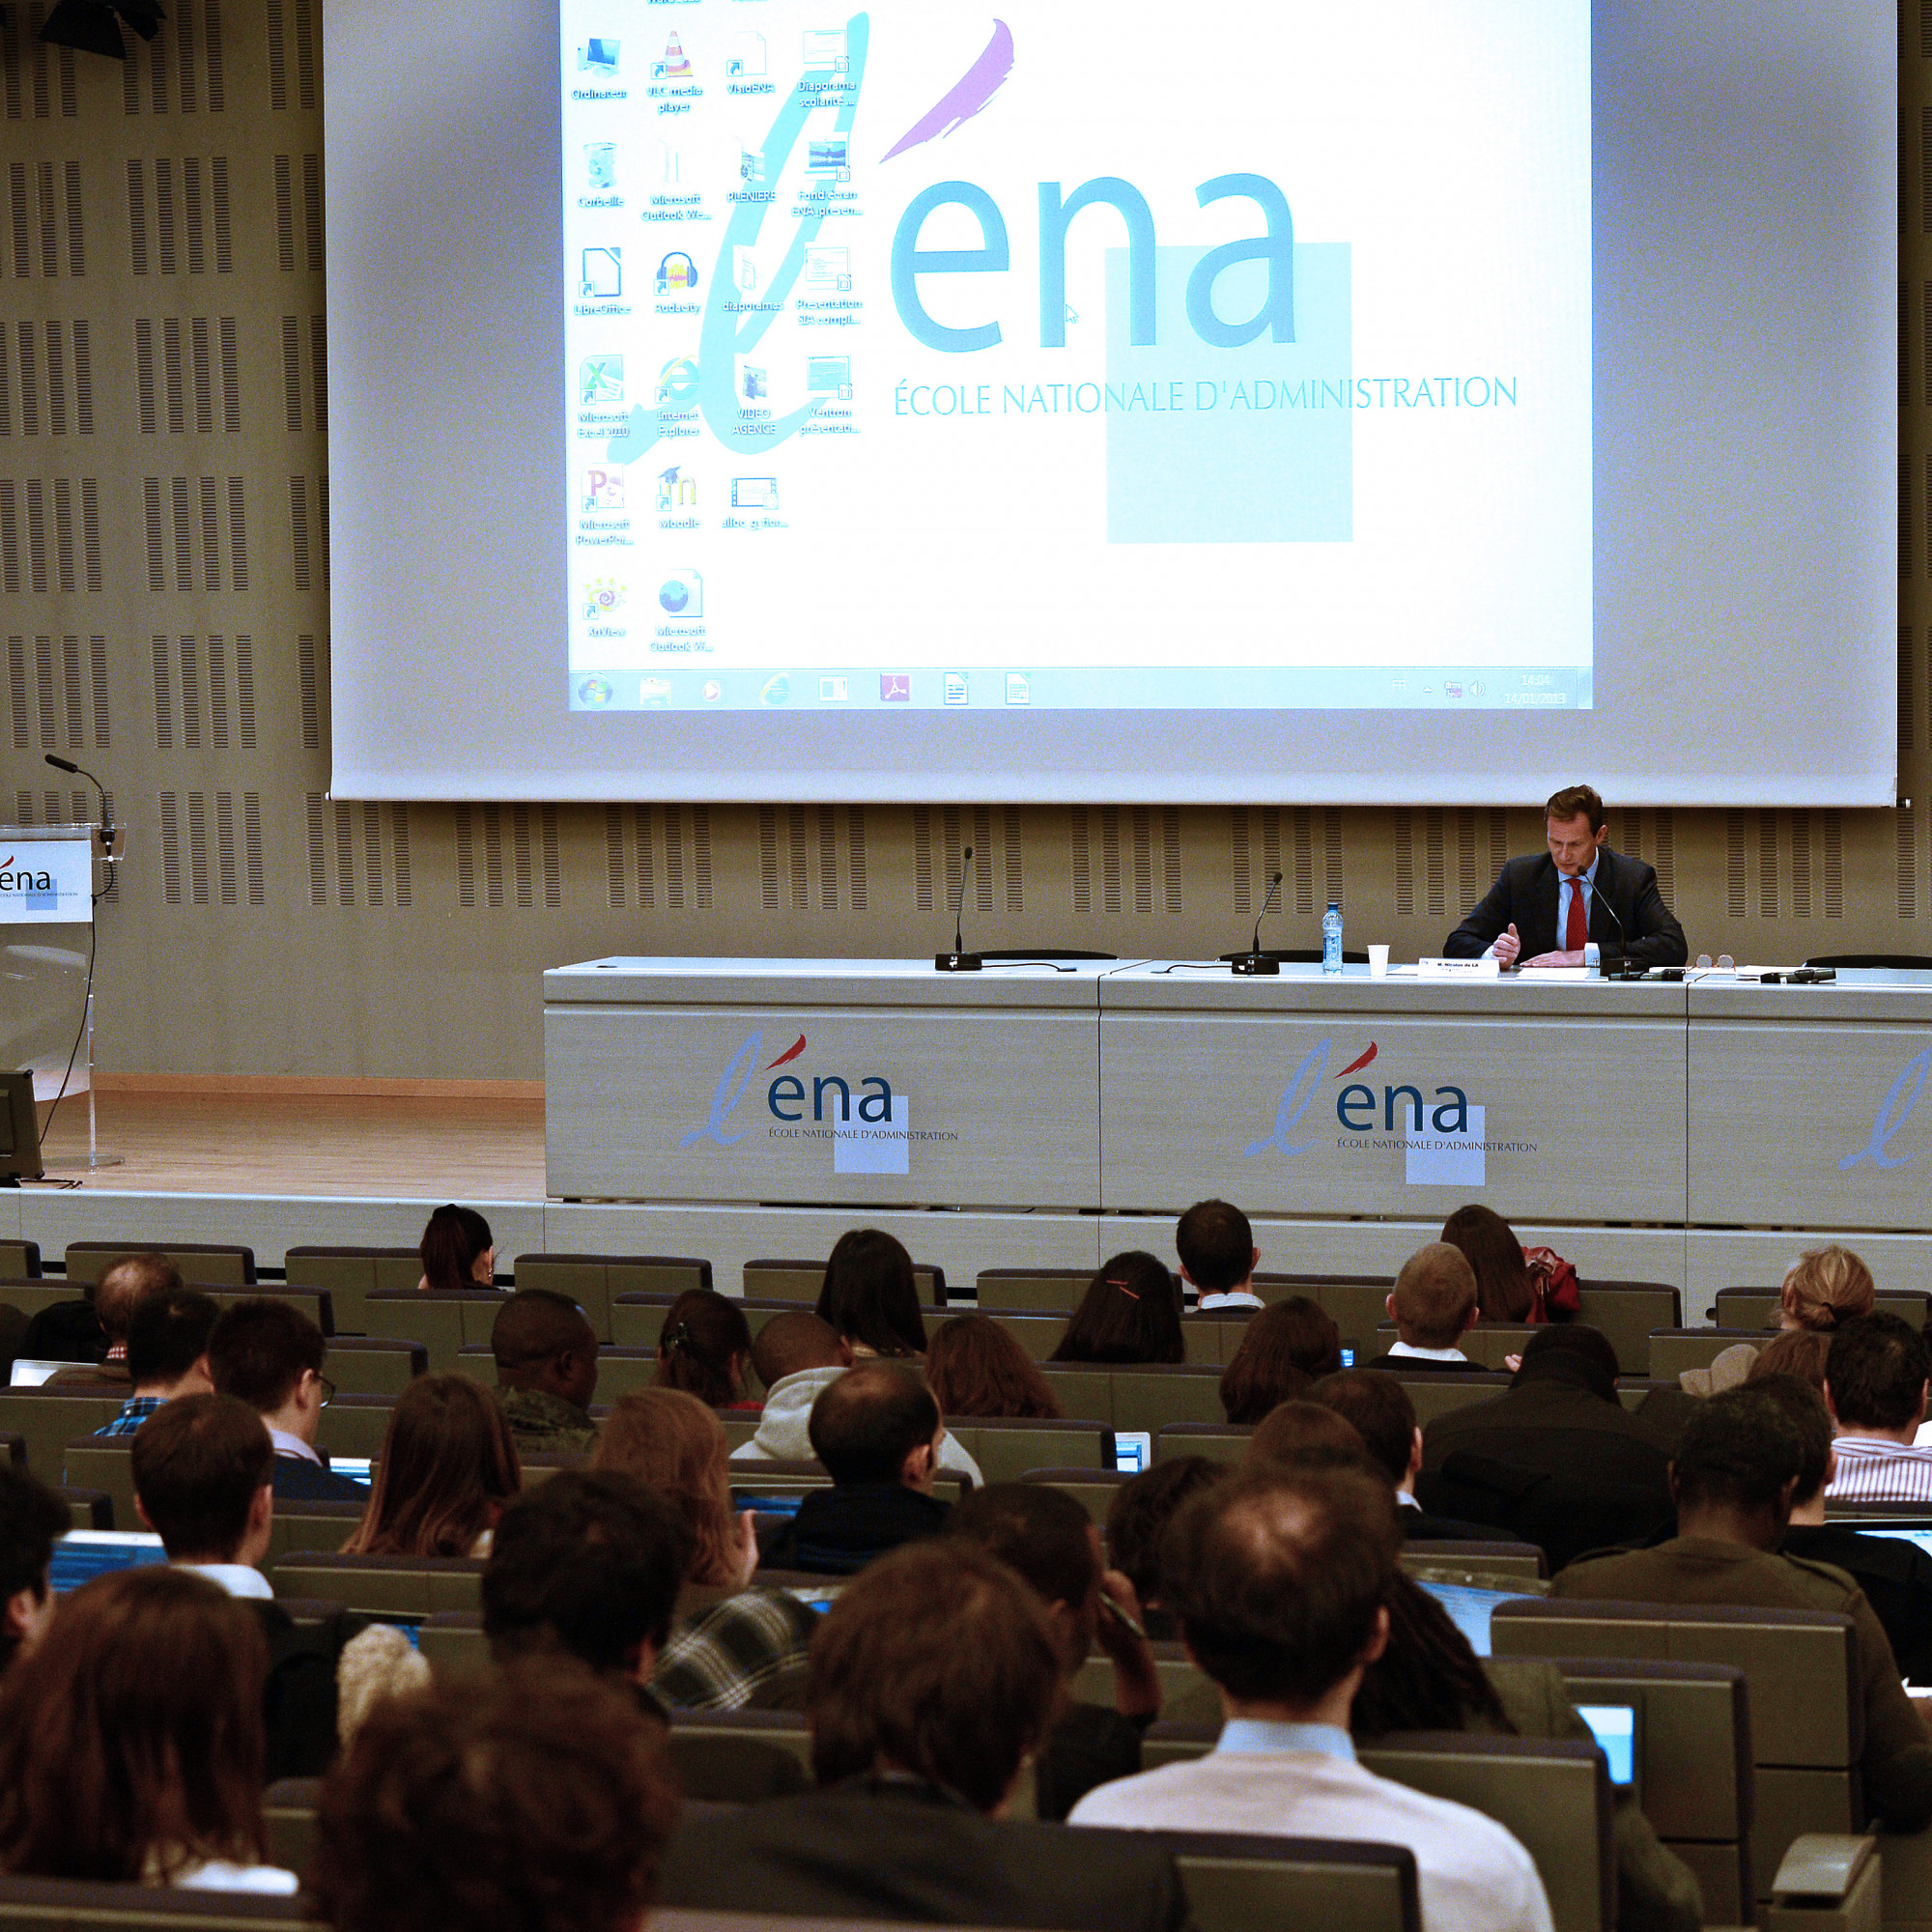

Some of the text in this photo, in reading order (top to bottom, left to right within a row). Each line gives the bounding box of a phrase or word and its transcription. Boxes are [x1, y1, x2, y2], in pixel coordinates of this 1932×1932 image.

[645, 85, 703, 98] VLC media
[798, 80, 856, 94] Diaporama
[571, 88, 628, 100] Ordinateur
[657, 101, 691, 115] player
[650, 193, 701, 206] Microsoft
[726, 189, 778, 203] PLENIERE
[798, 188, 858, 201] Fond écran
[578, 196, 625, 208] Corbeille
[641, 210, 683, 222] Outlook
[574, 304, 632, 316] LibreOffice
[654, 303, 700, 317] Audacity
[723, 300, 784, 314] diaporamas
[895, 376, 1517, 415] ÉCOLE NATIONALE D'ADMINISTRATION
[578, 412, 630, 423] Microsoft
[657, 410, 699, 422] Internet
[736, 409, 771, 419] VIDEO
[578, 426, 605, 439] Excel
[657, 425, 699, 439] Explorer
[732, 423, 777, 436] AGENCE
[580, 519, 631, 530] Microsoft
[659, 518, 700, 529] Moodle
[656, 626, 706, 638] Microsoft
[649, 641, 692, 653] Outlook
[1504, 693, 1566, 704] 14/01/2013
[768, 1126, 959, 1141] ÉCOLE NATIONALE D'ADMINISTRATION
[1337, 1136, 1538, 1151] ÉCOLE NATIONALE D'ADMINISTRATION
